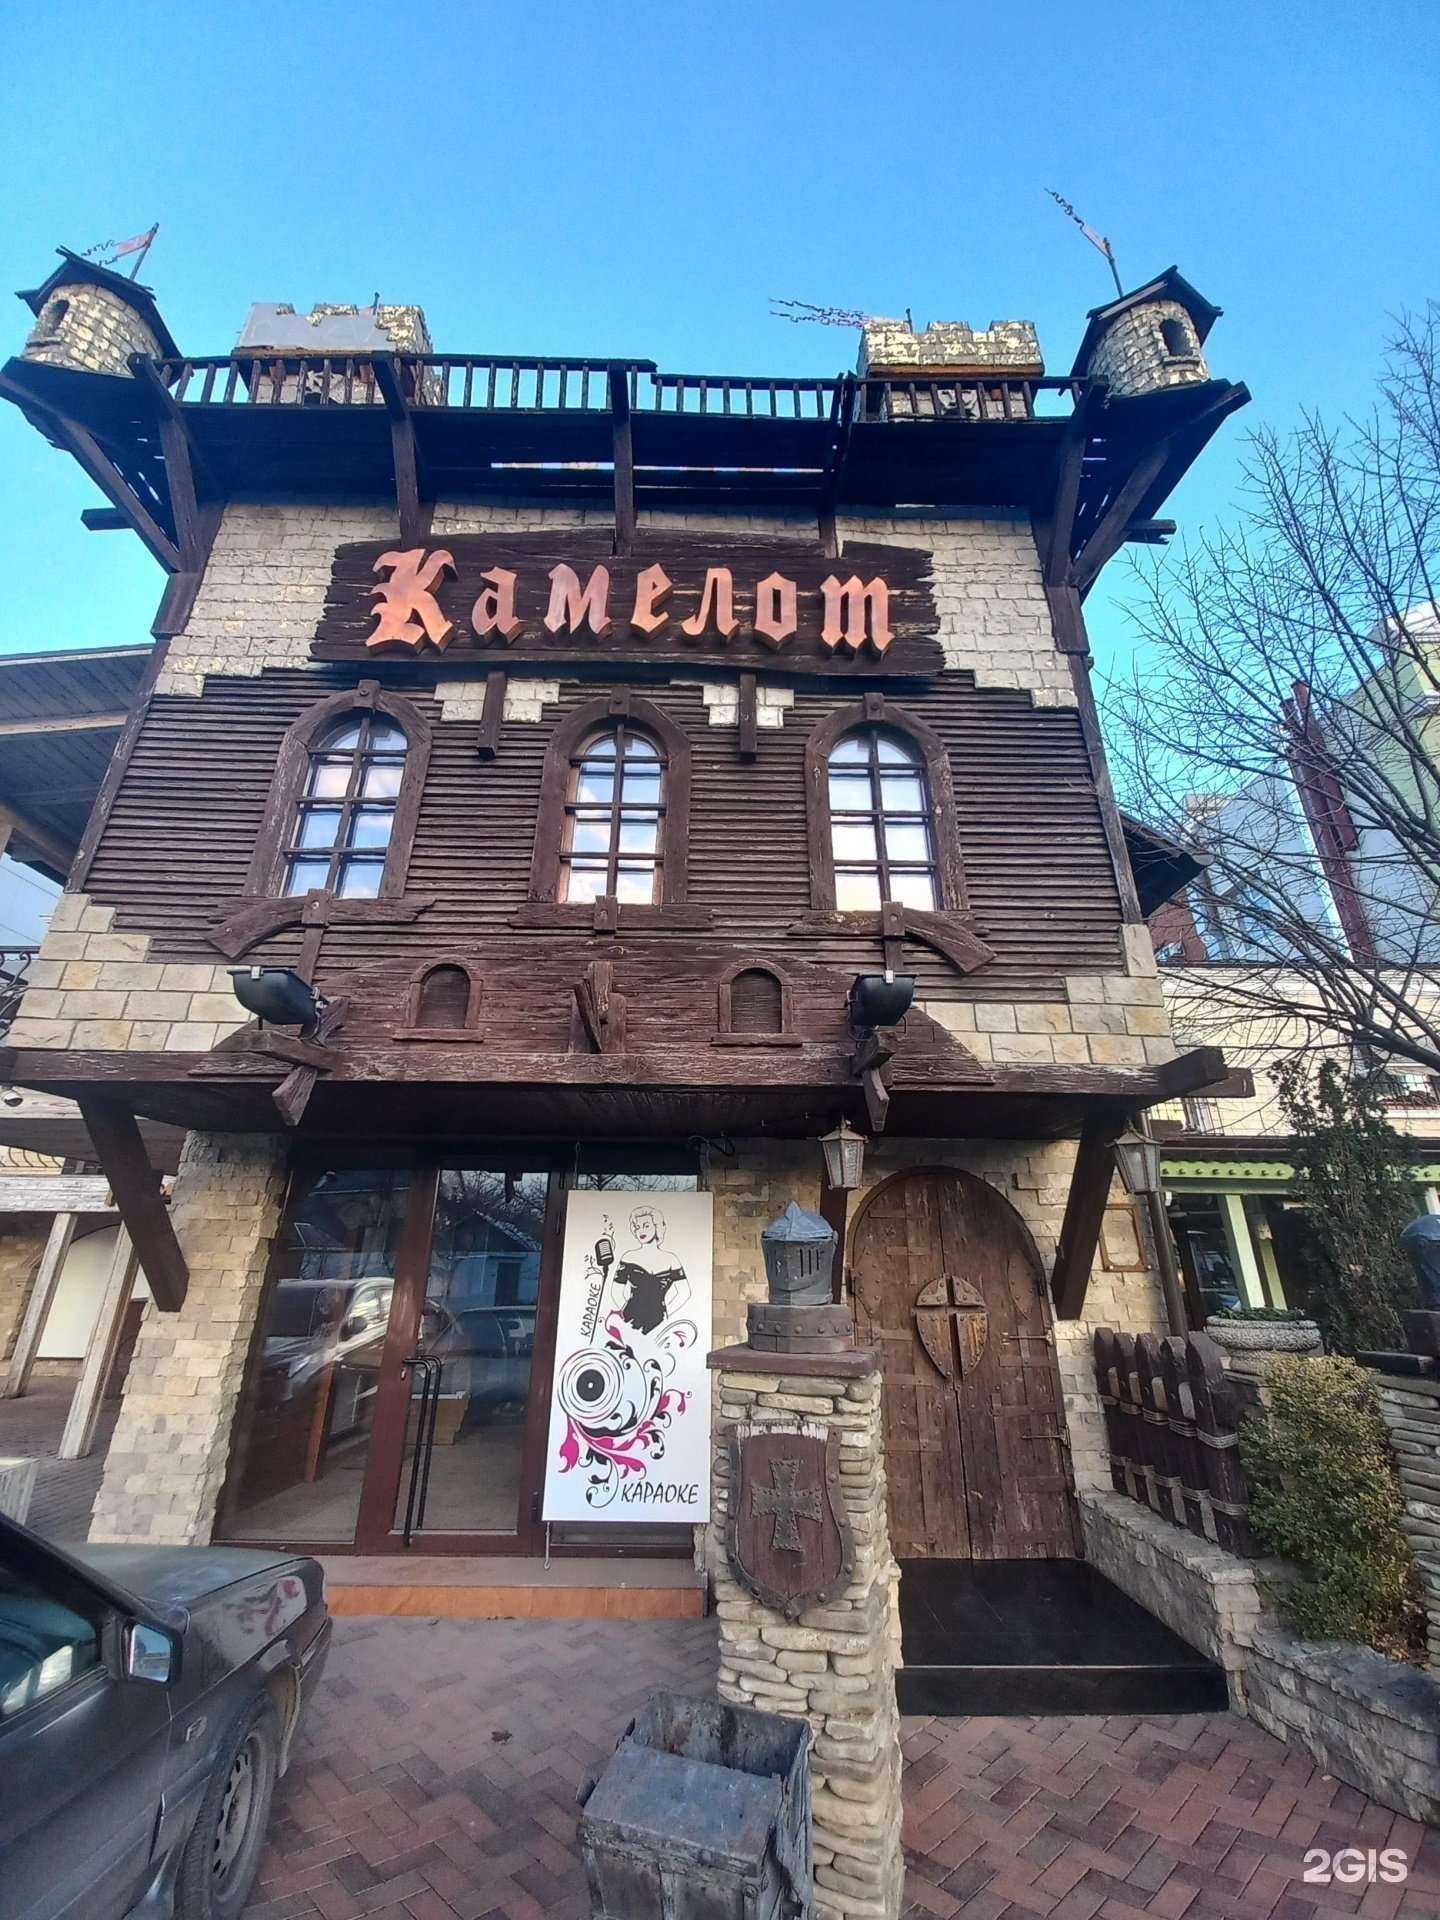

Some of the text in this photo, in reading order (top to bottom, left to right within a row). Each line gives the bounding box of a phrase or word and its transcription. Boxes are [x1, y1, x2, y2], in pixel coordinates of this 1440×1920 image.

[366, 548, 896, 656] Камелот
[580, 1283, 601, 1337] КАРАОКЕ
[621, 1482, 699, 1504] КАРАОКЕ
